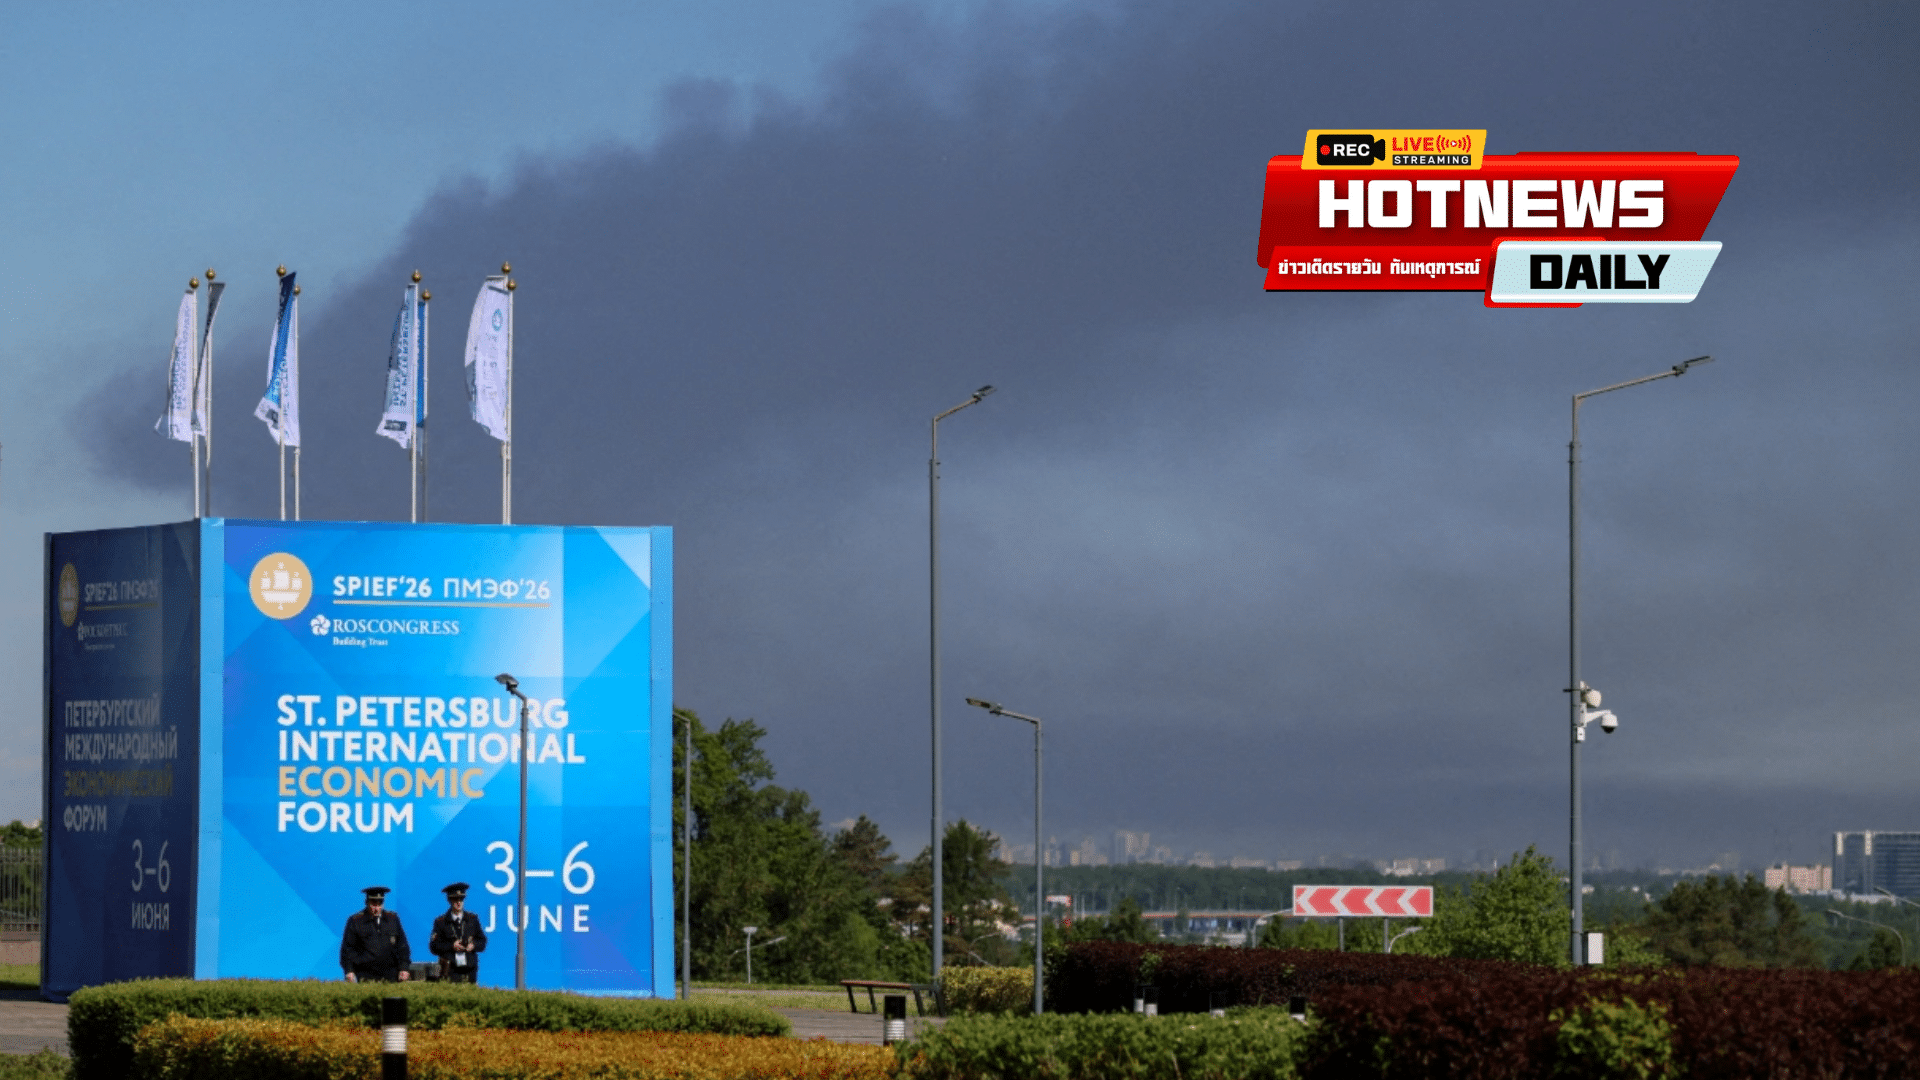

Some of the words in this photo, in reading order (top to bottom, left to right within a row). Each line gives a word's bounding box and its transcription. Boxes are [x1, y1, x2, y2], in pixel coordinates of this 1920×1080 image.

[333, 575, 433, 598] SPIEF'26
[443, 577, 551, 600] ПМЭФ'26
[333, 618, 460, 635] ROSCONGRESS
[333, 637, 367, 648] Building
[369, 637, 389, 646] Trust
[65, 692, 161, 728] ПЕТЕРБУРГСКИЙ
[277, 694, 328, 727] ST.
[335, 695, 570, 730] PETERSBURG
[65, 724, 178, 764] МЕЖДУНАРОДНЫЙ
[277, 730, 586, 764] INTERNATIONAL
[277, 765, 485, 798] ECONOMIC
[63, 804, 107, 832] ФОРУМ
[277, 801, 414, 833] FORUM
[131, 902, 170, 930] ИЮНЯ
[485, 904, 590, 933] JUNE
